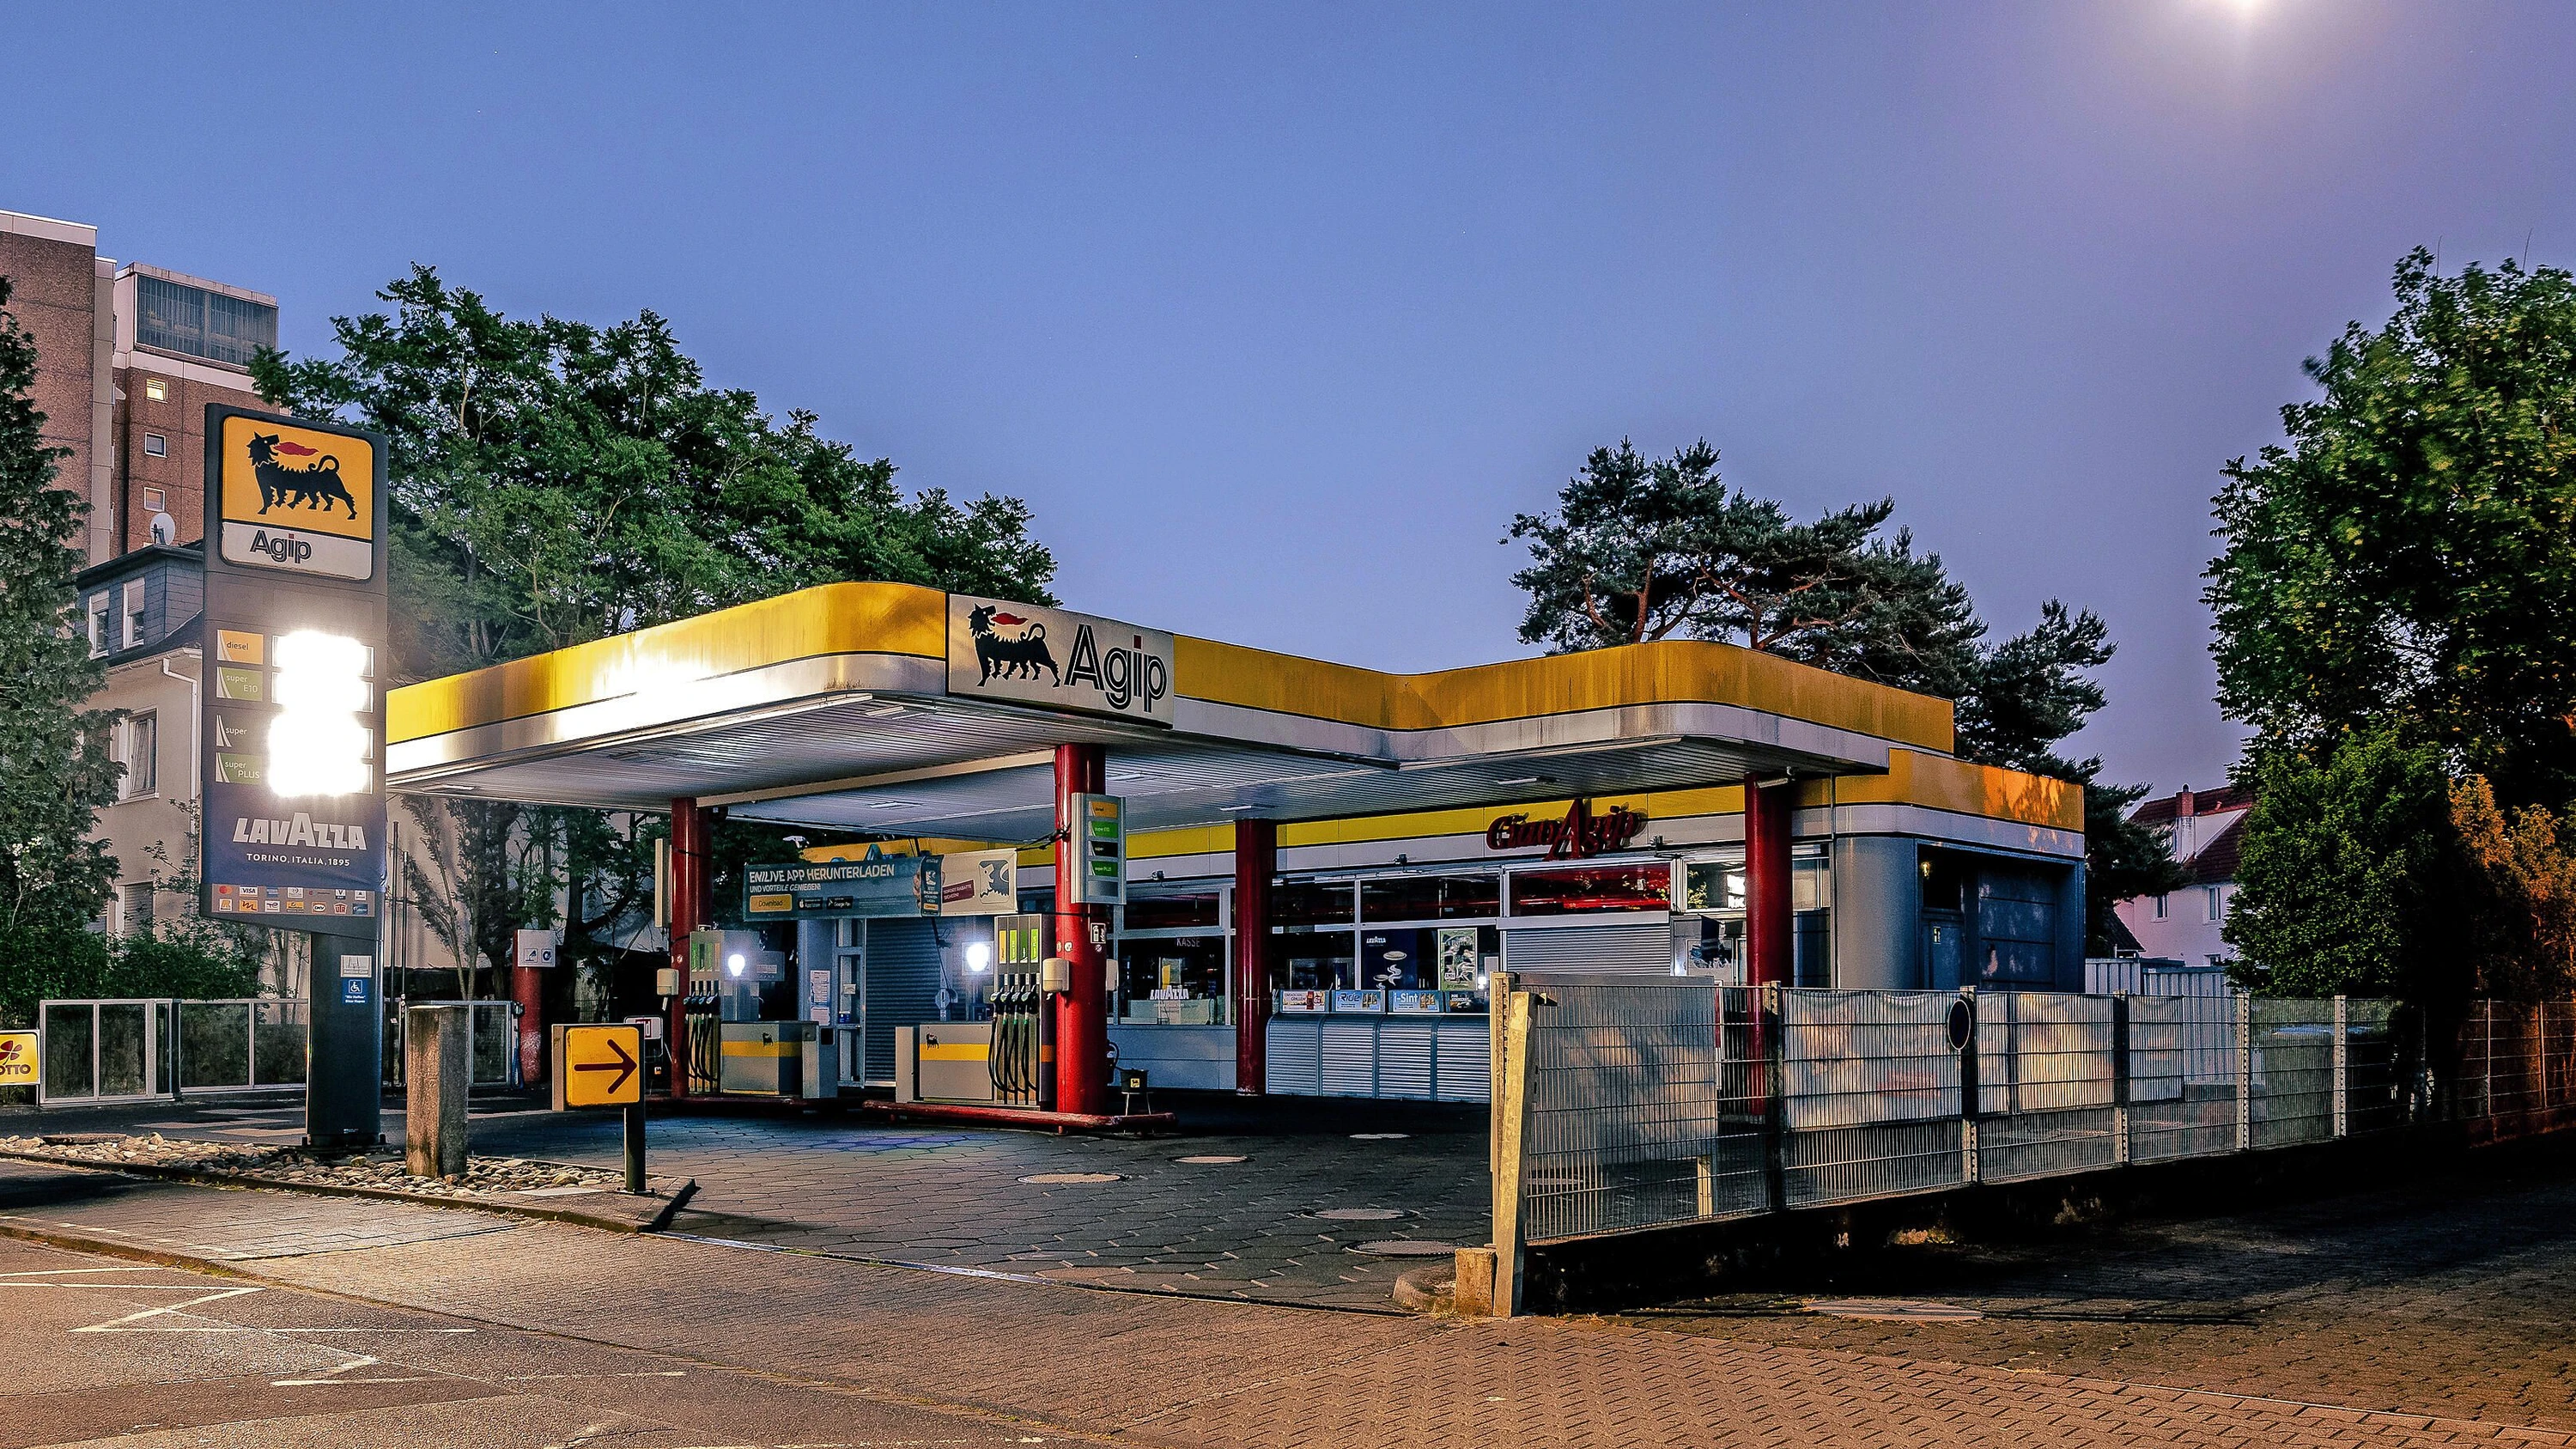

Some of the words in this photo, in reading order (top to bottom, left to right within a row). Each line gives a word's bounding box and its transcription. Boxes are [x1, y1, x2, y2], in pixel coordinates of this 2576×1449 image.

[249, 529, 312, 563] Agip
[226, 641, 249, 650] diesel
[1064, 623, 1167, 713] Agip
[243, 685, 258, 693] E10
[225, 728, 247, 736] super
[224, 761, 246, 770] super
[238, 770, 260, 779] PLUS
[233, 812, 368, 850] LAVAZZA
[246, 853, 290, 864] TORINO,
[292, 856, 327, 866] ITALIA,
[328, 858, 350, 867] 1895
[787, 868, 805, 881] APP
[806, 864, 895, 881] HERUNTERLADEN
[750, 885, 762, 893] UND
[1176, 938, 1200, 947] KASSE
[1150, 984, 1190, 1001] LAVAZZA
[1394, 993, 1419, 1003] i-Sint
[0, 1063, 32, 1075] OTTO
